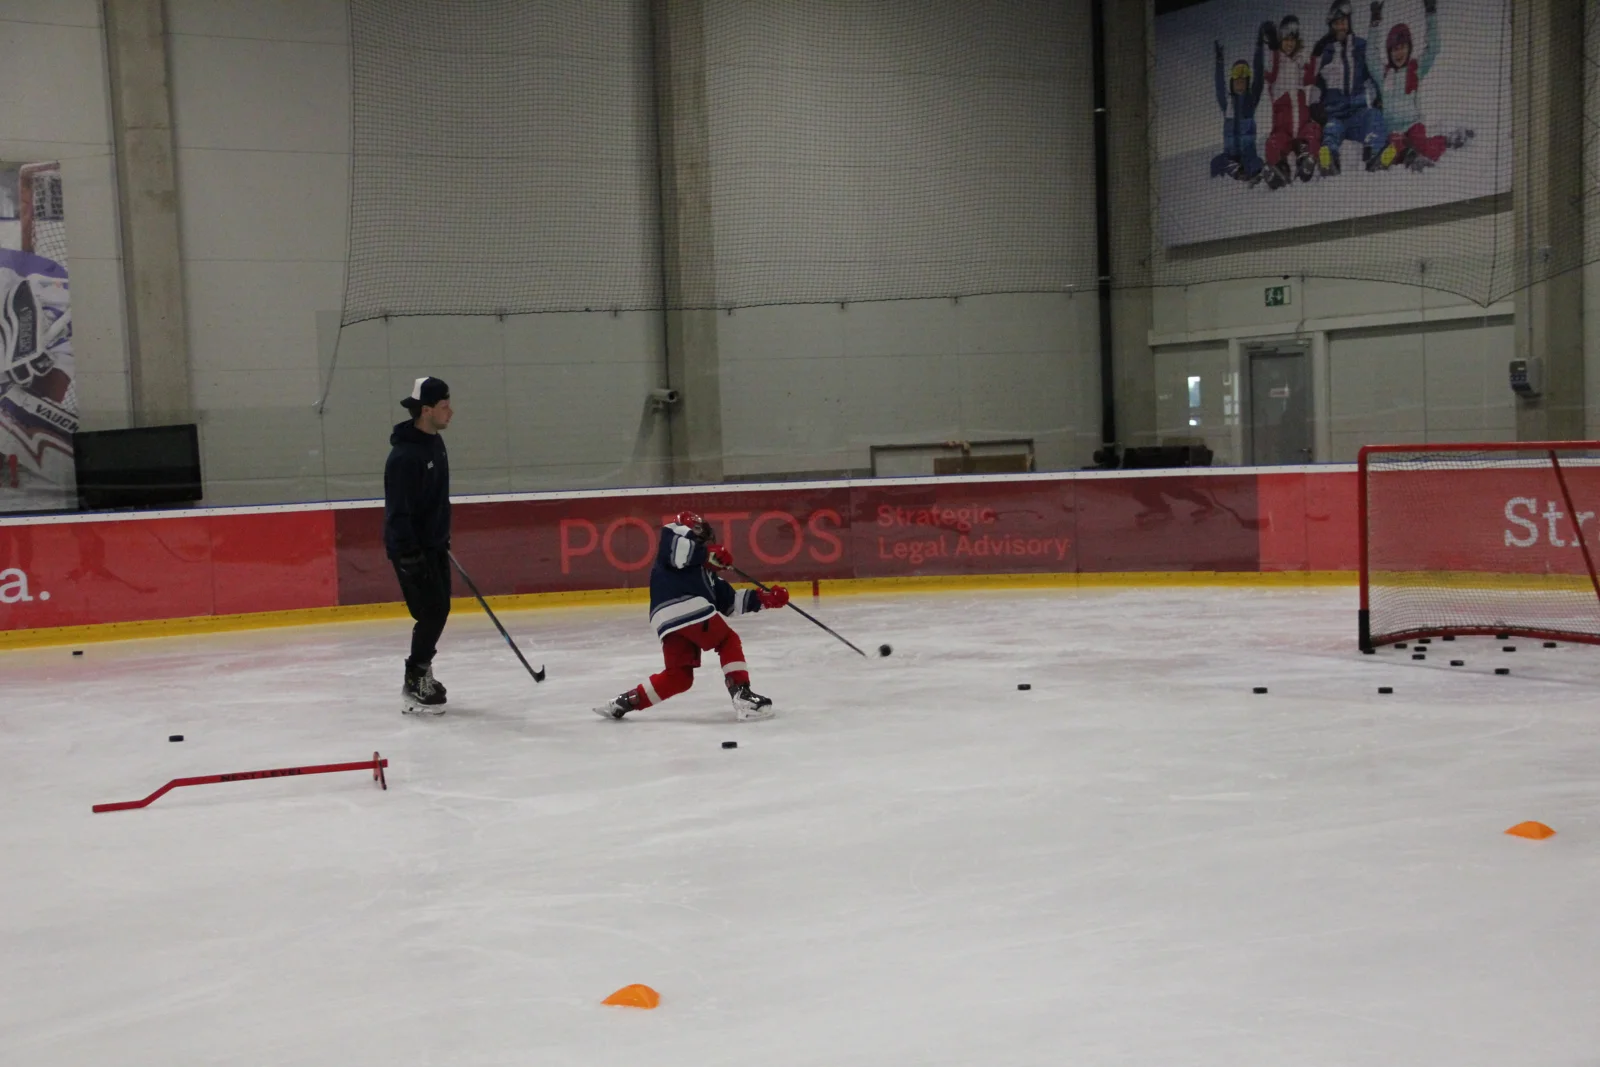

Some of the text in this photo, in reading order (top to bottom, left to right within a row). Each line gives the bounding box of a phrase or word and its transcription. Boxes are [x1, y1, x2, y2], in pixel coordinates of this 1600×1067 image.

[877, 503, 995, 531] Strategic
[1503, 496, 1600, 547] Str
[560, 509, 842, 574] POTOS
[878, 533, 1070, 563] Legal Advisory
